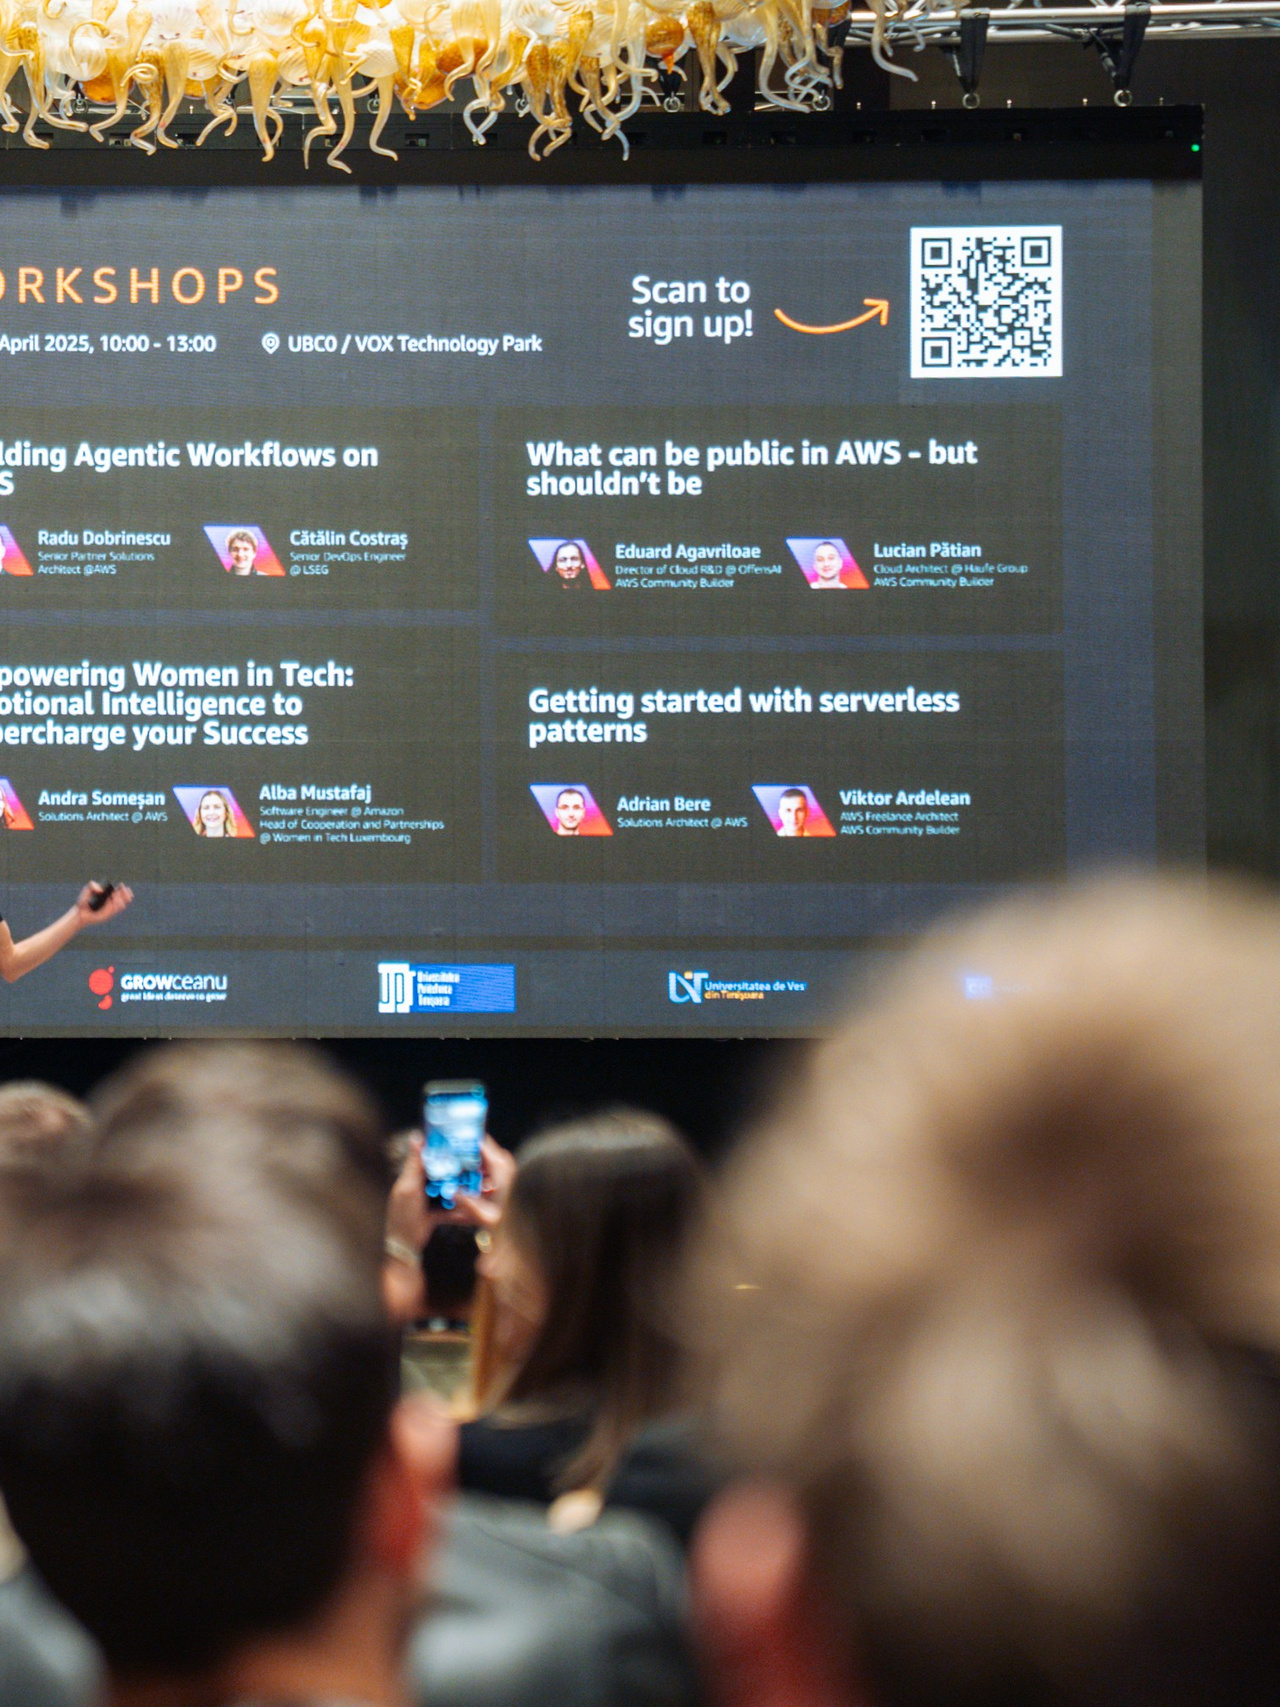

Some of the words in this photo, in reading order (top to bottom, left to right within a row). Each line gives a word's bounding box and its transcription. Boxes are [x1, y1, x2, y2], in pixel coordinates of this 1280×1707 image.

[632, 274, 706, 304] Scan
[715, 276, 750, 303] to
[628, 309, 693, 345] sign
[704, 309, 753, 344] up!
[45, 334, 94, 354] 2025,
[100, 334, 150, 352] 10:00
[167, 334, 217, 352] 13:00
[341, 334, 351, 354] /
[355, 334, 394, 352] VOX
[397, 334, 499, 356] Technology
[503, 334, 542, 351] Park
[74, 441, 180, 472] Agentic
[187, 441, 336, 467] Workflows
[343, 447, 378, 467] on
[526, 440, 602, 467] What
[608, 447, 657, 467] can
[665, 440, 700, 466] be
[707, 439, 794, 471] public
[802, 439, 828, 465] in
[835, 440, 901, 465] AWS
[929, 438, 978, 464] but
[668, 470, 702, 495] be
[38, 530, 78, 545] Radu
[83, 530, 171, 545] Dobrinescu
[290, 530, 346, 546] Cătălin
[38, 551, 68, 562] Senior
[71, 551, 106, 561] Partner
[110, 551, 154, 561] Solutions
[616, 543, 672, 559] Eduard
[675, 543, 761, 562] Agavriloae
[874, 543, 926, 557] Lucian
[930, 542, 982, 557] Pătian
[290, 551, 320, 562] Senior
[324, 551, 361, 563] DevOps
[364, 551, 406, 564] Engineer
[38, 564, 81, 575] Architect
[84, 564, 116, 577] @AWS
[290, 564, 300, 577] @
[303, 564, 329, 576] LSEG
[616, 564, 653, 575] Director
[657, 564, 667, 575] of
[670, 564, 698, 575] Cloud
[700, 564, 722, 575] R&D
[726, 564, 736, 577] @
[874, 563, 903, 574] Cloud
[905, 563, 948, 574] Architect
[951, 563, 963, 576] @
[965, 562, 994, 574] Haufe
[997, 563, 1028, 574] Group
[616, 577, 639, 588] AWS
[640, 577, 697, 589] Community
[700, 577, 734, 588] Builder
[874, 576, 897, 587] AWS
[899, 576, 957, 588] Community
[959, 575, 994, 587] Builder
[132, 661, 239, 687] Women
[247, 660, 273, 686] in
[280, 660, 353, 687] Tech:
[102, 689, 266, 721] Intelligence
[272, 691, 303, 716] to
[529, 686, 634, 718] Getting
[641, 686, 742, 713] started
[749, 686, 812, 712] with
[819, 686, 960, 712] serverless
[132, 724, 198, 751] your
[203, 719, 308, 745] Success
[529, 718, 647, 748] patterns
[38, 789, 88, 805] Andra
[259, 784, 297, 800] Alba
[301, 783, 371, 804] Mustafaj
[840, 789, 893, 805] Viktor
[896, 789, 971, 805] Ardelean
[617, 796, 670, 811] Adrian
[674, 796, 711, 811] Bere
[39, 811, 84, 822] Solutions
[87, 811, 129, 821] Architect
[132, 811, 143, 824] @
[145, 811, 167, 822] AWS
[260, 805, 303, 816] Software
[306, 806, 347, 818] Engineer
[351, 806, 361, 818] @
[364, 806, 403, 816] Amazon
[841, 811, 864, 822] AWS
[866, 810, 913, 822] Freelance
[915, 811, 958, 822] Architect
[260, 819, 286, 830] Head
[287, 819, 298, 830] of
[301, 818, 360, 830] Cooperation
[363, 820, 381, 830] and
[384, 819, 444, 831] Partnerships
[618, 816, 663, 828] Solutions
[666, 817, 708, 828] Architect
[711, 817, 722, 829] @
[725, 816, 748, 828] AWS
[841, 824, 864, 835] AWS
[866, 825, 923, 836] Community
[926, 825, 959, 835] Builder
[260, 832, 271, 845] @
[273, 832, 311, 843] Women
[313, 831, 323, 843] in
[326, 832, 348, 843] Tech
[350, 832, 410, 845] Luxembourg
[120, 974, 228, 990] GROWceanu
[705, 982, 770, 991] Universitatea
[773, 982, 785, 991] de
[787, 982, 808, 991] Ves
[704, 991, 720, 999] din
